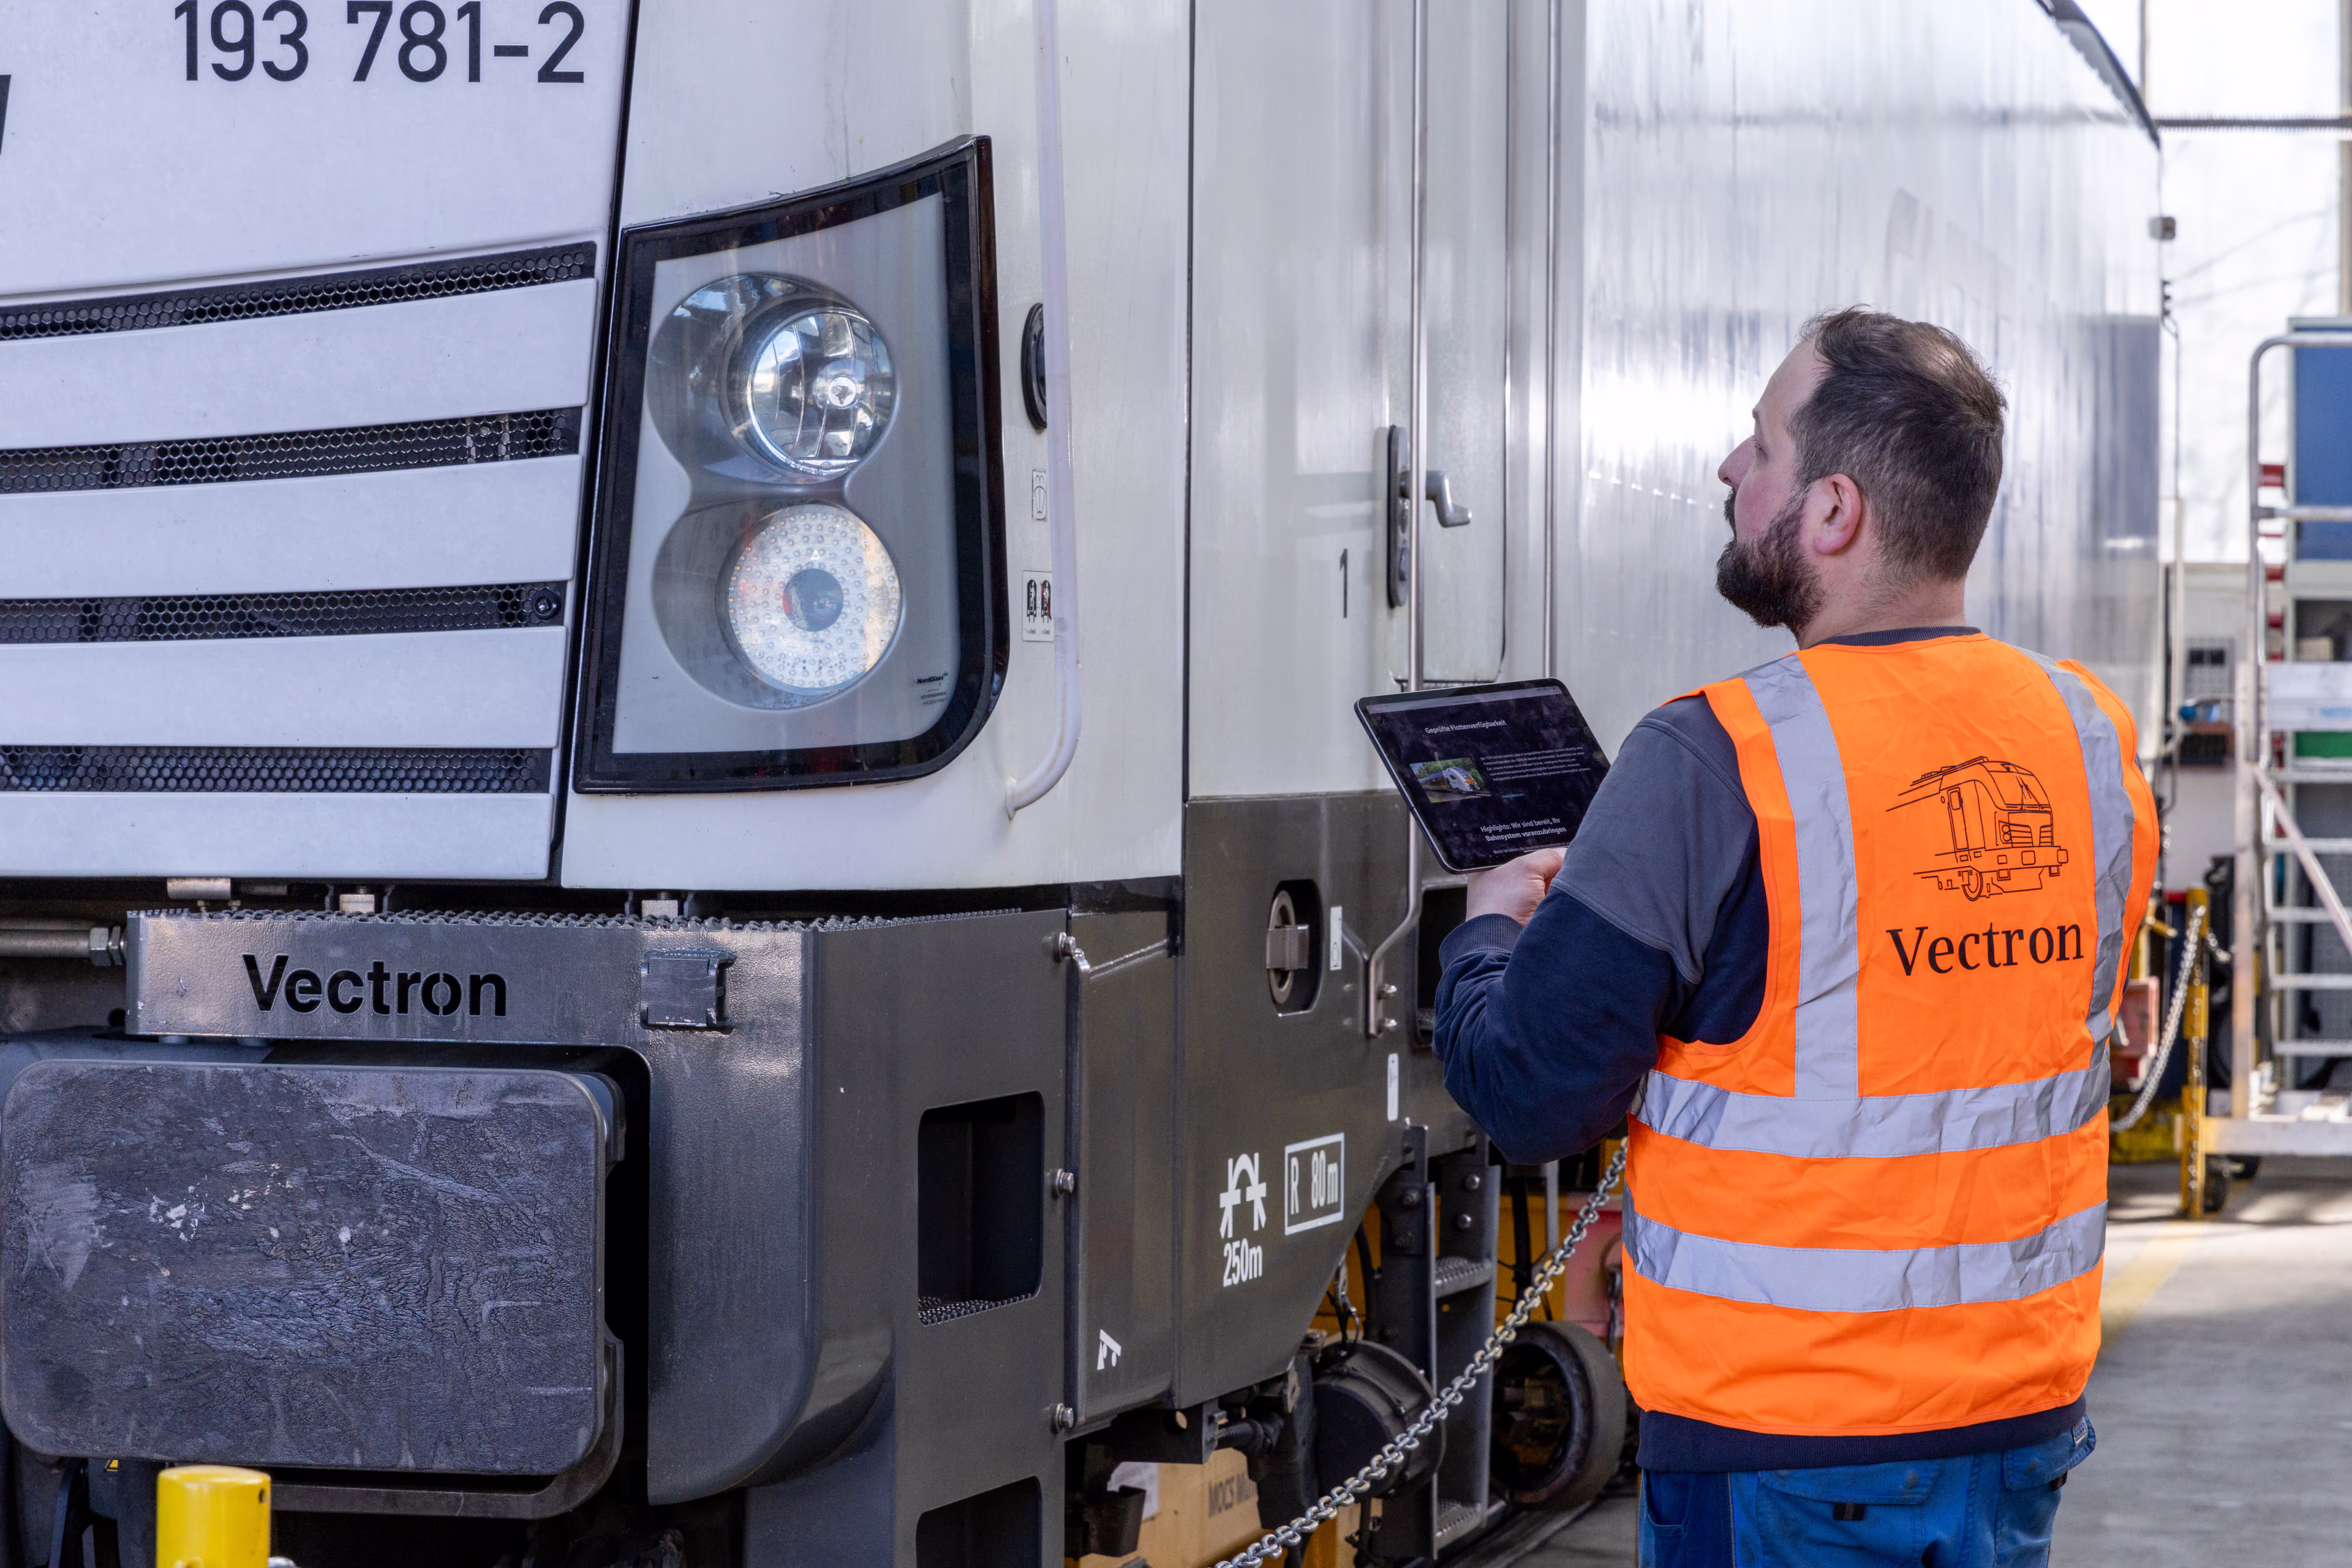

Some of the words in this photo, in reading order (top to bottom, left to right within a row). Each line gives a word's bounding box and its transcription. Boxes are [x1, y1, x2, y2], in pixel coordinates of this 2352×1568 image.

[175, 0, 308, 81] 193
[347, 1, 585, 83] 781-2
[917, 676, 944, 684] NordGlass
[1425, 725, 1451, 734] Geprüfte
[1450, 719, 1507, 731] Flottenverfügbarkeit
[1480, 824, 1512, 833] Highlights:
[1485, 832, 1521, 842] Bahnsystem
[1521, 827, 1567, 837] voranzubringen
[1886, 922, 2084, 976] Vectron
[242, 953, 507, 1017] Vectron
[1291, 1157, 1300, 1215] R
[1223, 1238, 1263, 1287] 250m
